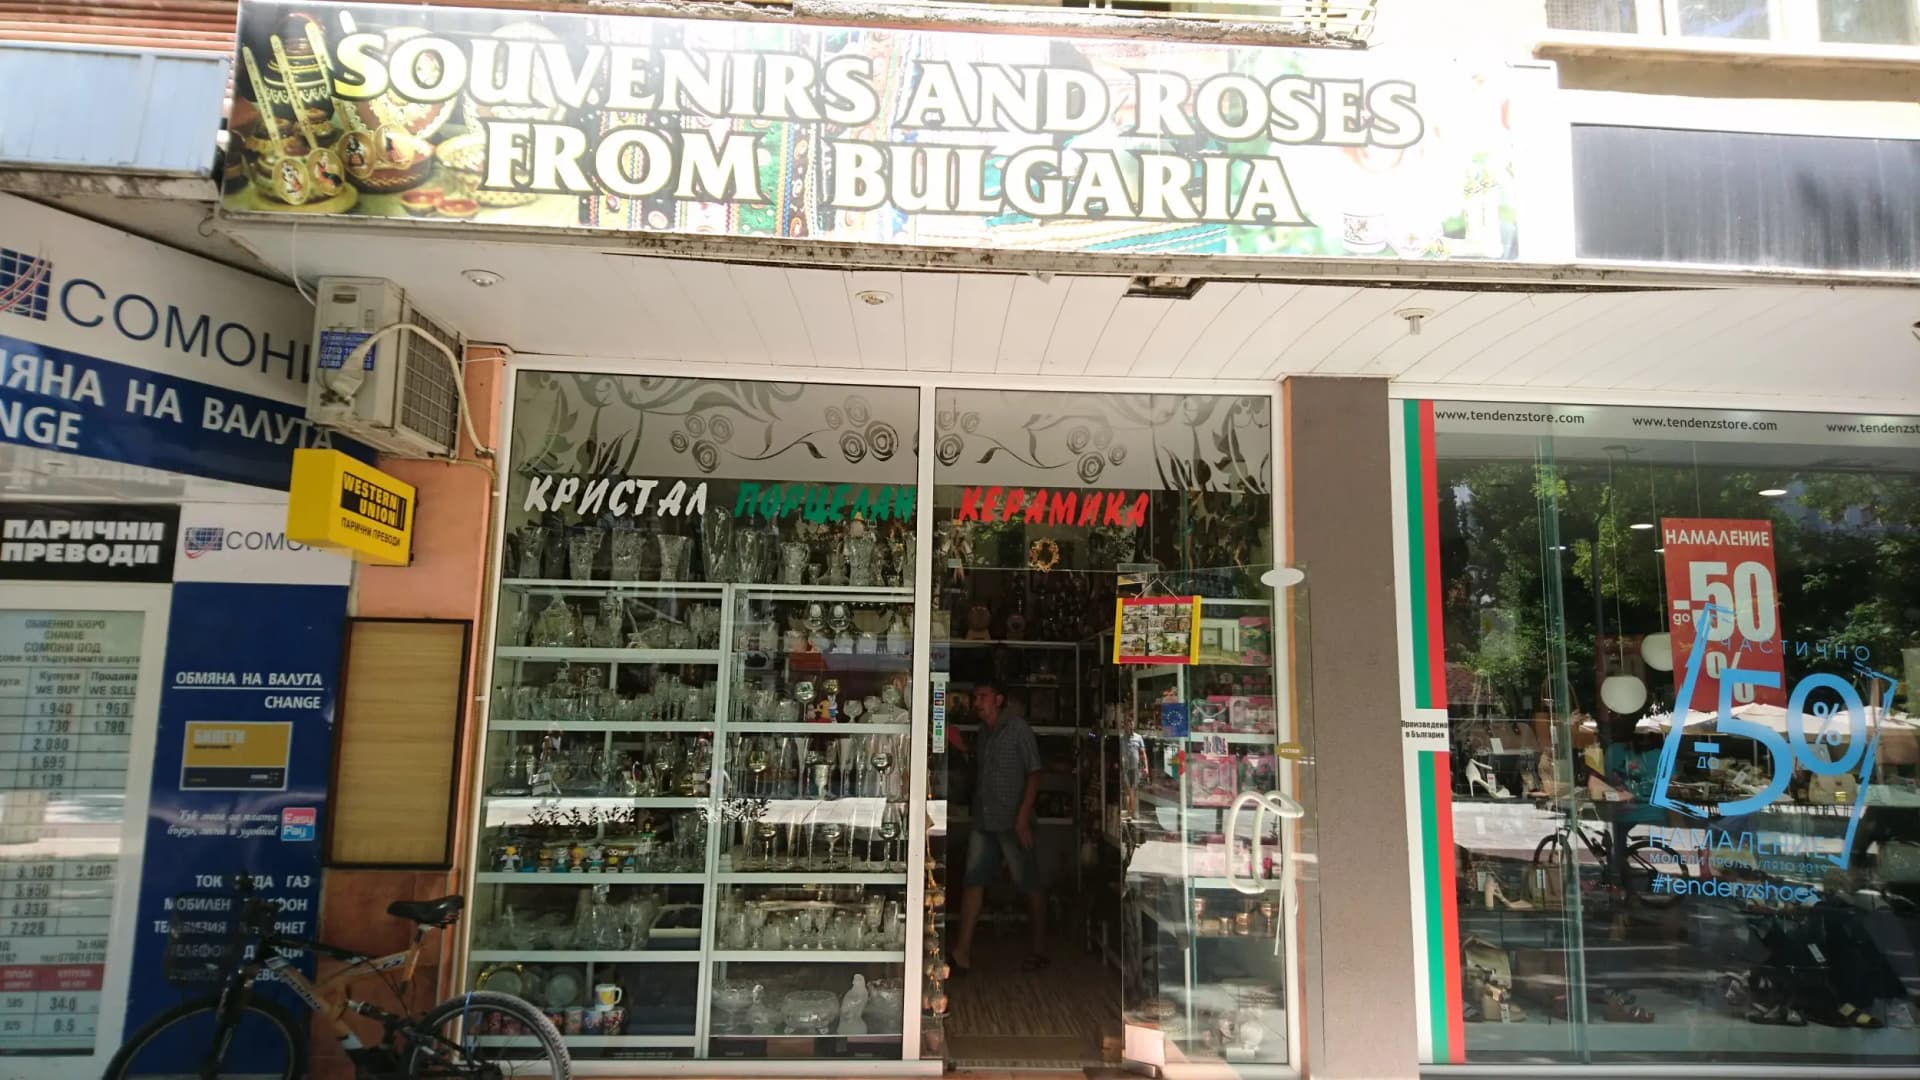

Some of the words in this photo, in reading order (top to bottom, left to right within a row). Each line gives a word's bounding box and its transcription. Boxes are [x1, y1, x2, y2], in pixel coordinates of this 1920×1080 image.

[333, 31, 883, 128] SOUVENIRS
[895, 59, 1111, 136] AND
[1122, 67, 1424, 148] ROSES
[480, 120, 765, 201] FROM
[827, 138, 1317, 228] BULGARIA
[60, 278, 310, 385] СОМОН
[0, 348, 104, 407] ЯНА
[125, 379, 183, 424] НА
[202, 396, 333, 449] ВАЛУТА
[1435, 409, 1586, 425] www.tendenzstore.com
[1633, 415, 1778, 431] www.tendenzstore.com
[343, 474, 398, 510] WESTERN
[523, 475, 707, 516] КРИСТАЛ
[734, 482, 915, 524] ПОРЦЕЛАН
[958, 485, 1150, 528] КЕРАМИКА
[359, 497, 397, 526] UNION
[3, 519, 165, 541] ПАРИЧНИ
[341, 517, 372, 535] ПАРИЧНИ
[373, 529, 400, 547] ПРЕВОДИ
[1665, 529, 1769, 547] НАМАЛЕНИЕ
[0, 542, 160, 567] ПРЕВОДИ
[44, 631, 84, 640] CHANGE
[1721, 639, 1870, 662] ЧАСТИЧНО
[35, 685, 53, 695] WE
[56, 685, 80, 695] BUY
[89, 686, 107, 696] WE
[110, 686, 136, 696] SELL
[176, 672, 236, 686] ОБМЯНА
[242, 672, 262, 686] НА
[268, 672, 322, 686] ВАЛУТА
[264, 696, 321, 709] CHANGE
[1650, 826, 1827, 860] НАМАЛЕНИЕ
[195, 875, 223, 888] ТОК
[286, 875, 311, 888] ГАЗ
[1651, 873, 1822, 904] #tendenzshoes
